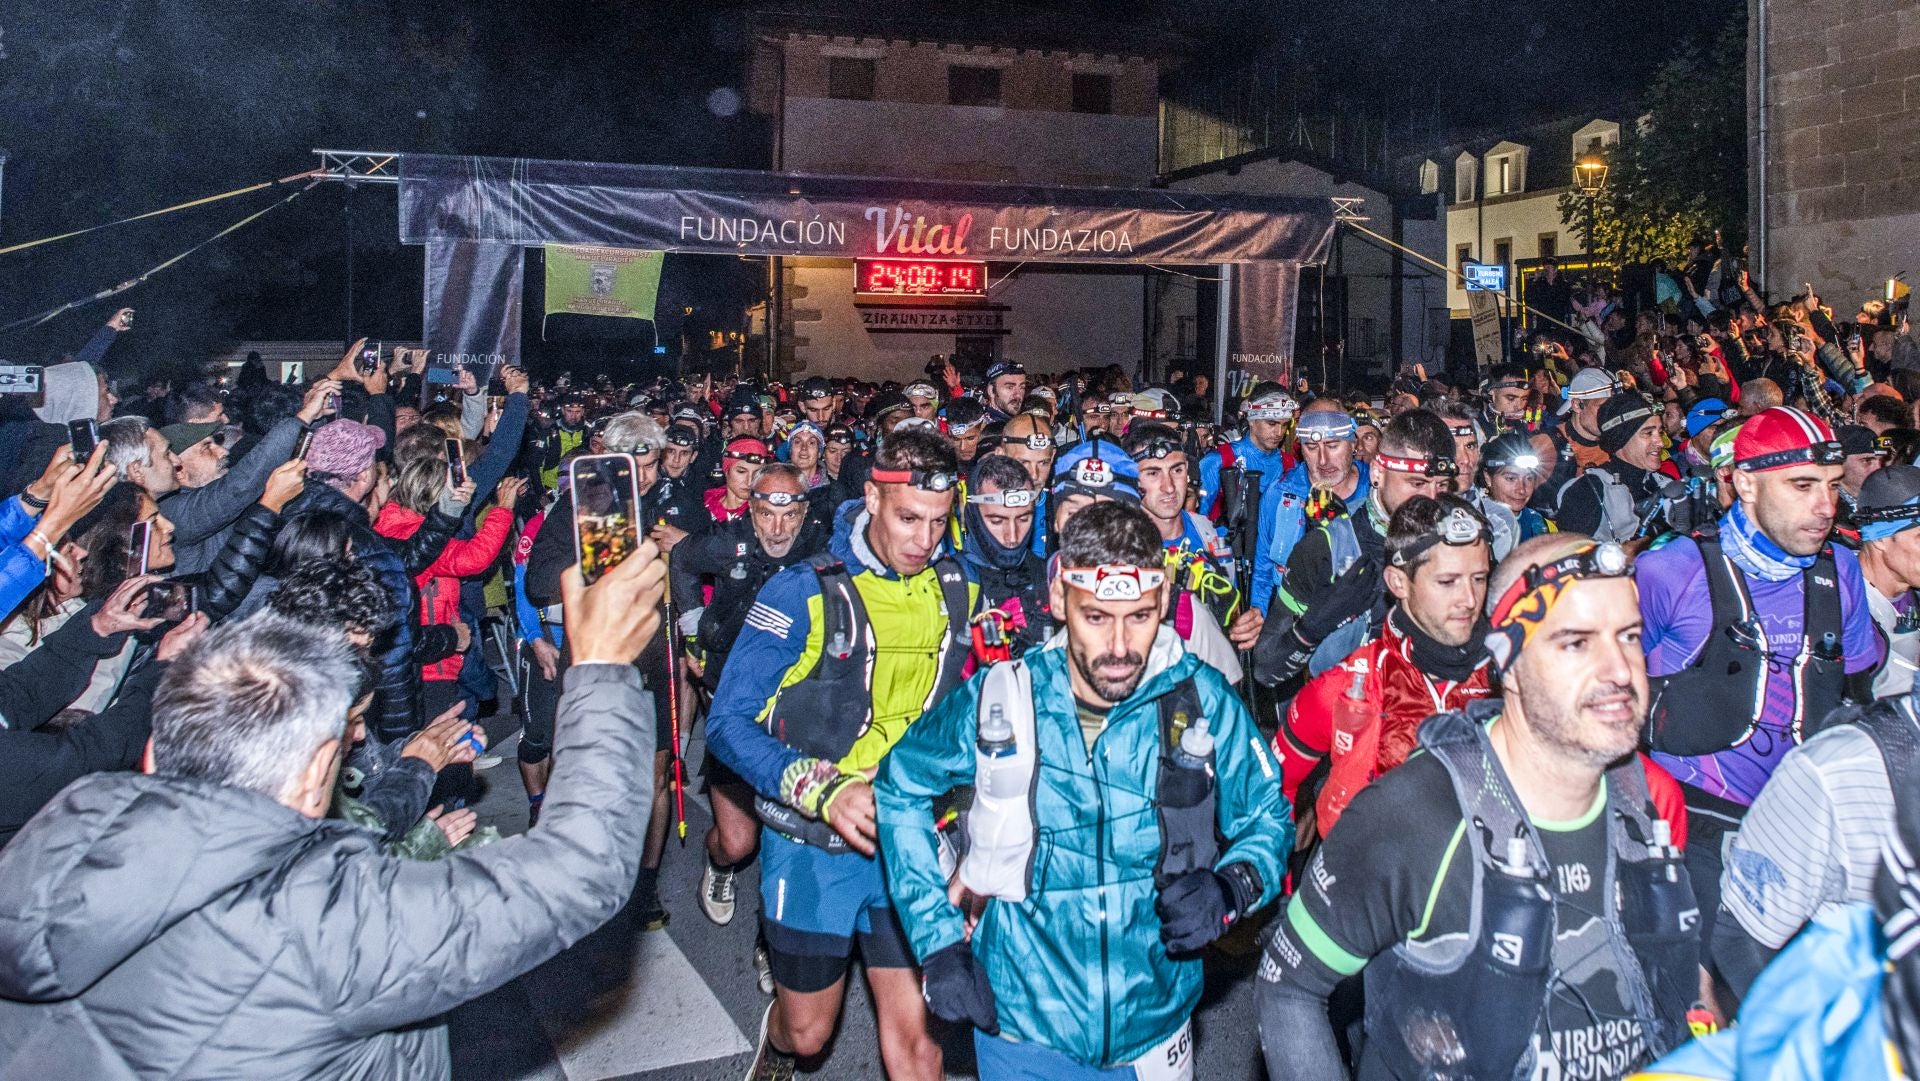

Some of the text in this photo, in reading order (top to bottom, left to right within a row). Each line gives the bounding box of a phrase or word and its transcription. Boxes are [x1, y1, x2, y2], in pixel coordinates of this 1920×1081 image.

[681, 206, 1133, 255] FUNDACIÓN Vital FUNDAZIOA
[870, 265, 972, 287] 24:00:14
[437, 351, 506, 365] FUNDACIÓN
[1232, 352, 1282, 364] FUNDACIÓN
[762, 801, 790, 821] Vital
